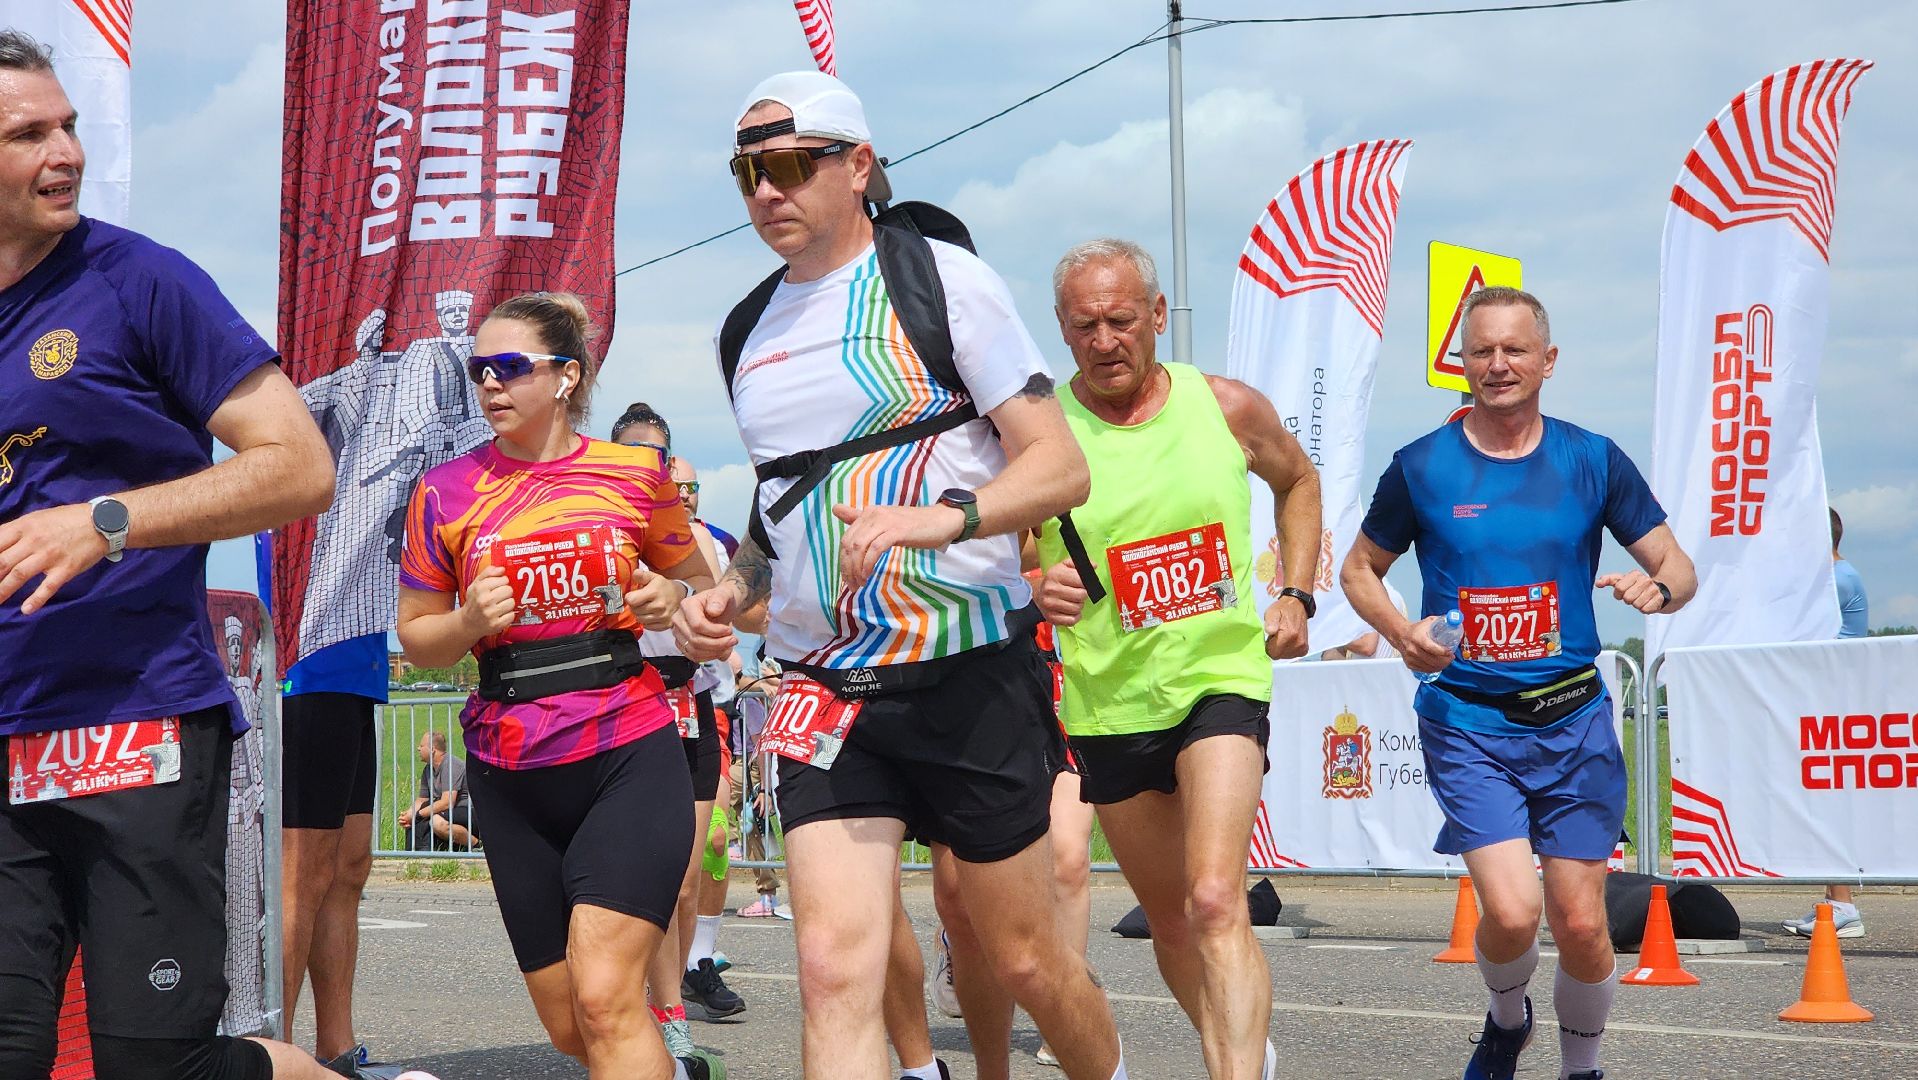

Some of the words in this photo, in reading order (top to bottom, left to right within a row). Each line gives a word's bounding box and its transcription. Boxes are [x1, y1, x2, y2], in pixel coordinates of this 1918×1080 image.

[495, 10, 575, 238] РУБЕЖ
[37, 363, 71, 377] МАРАФОН
[1309, 367, 1327, 466] рнатора
[1710, 312, 1743, 537] МОСОБЛ
[1739, 360, 1773, 536] СПОРТ
[517, 560, 588, 605] 2136
[1131, 558, 1209, 609] 2082
[1475, 611, 1537, 645] 2027
[1546, 685, 1588, 707] DEMIX
[37, 722, 140, 772] 2092
[1800, 713, 1918, 751] МОС
